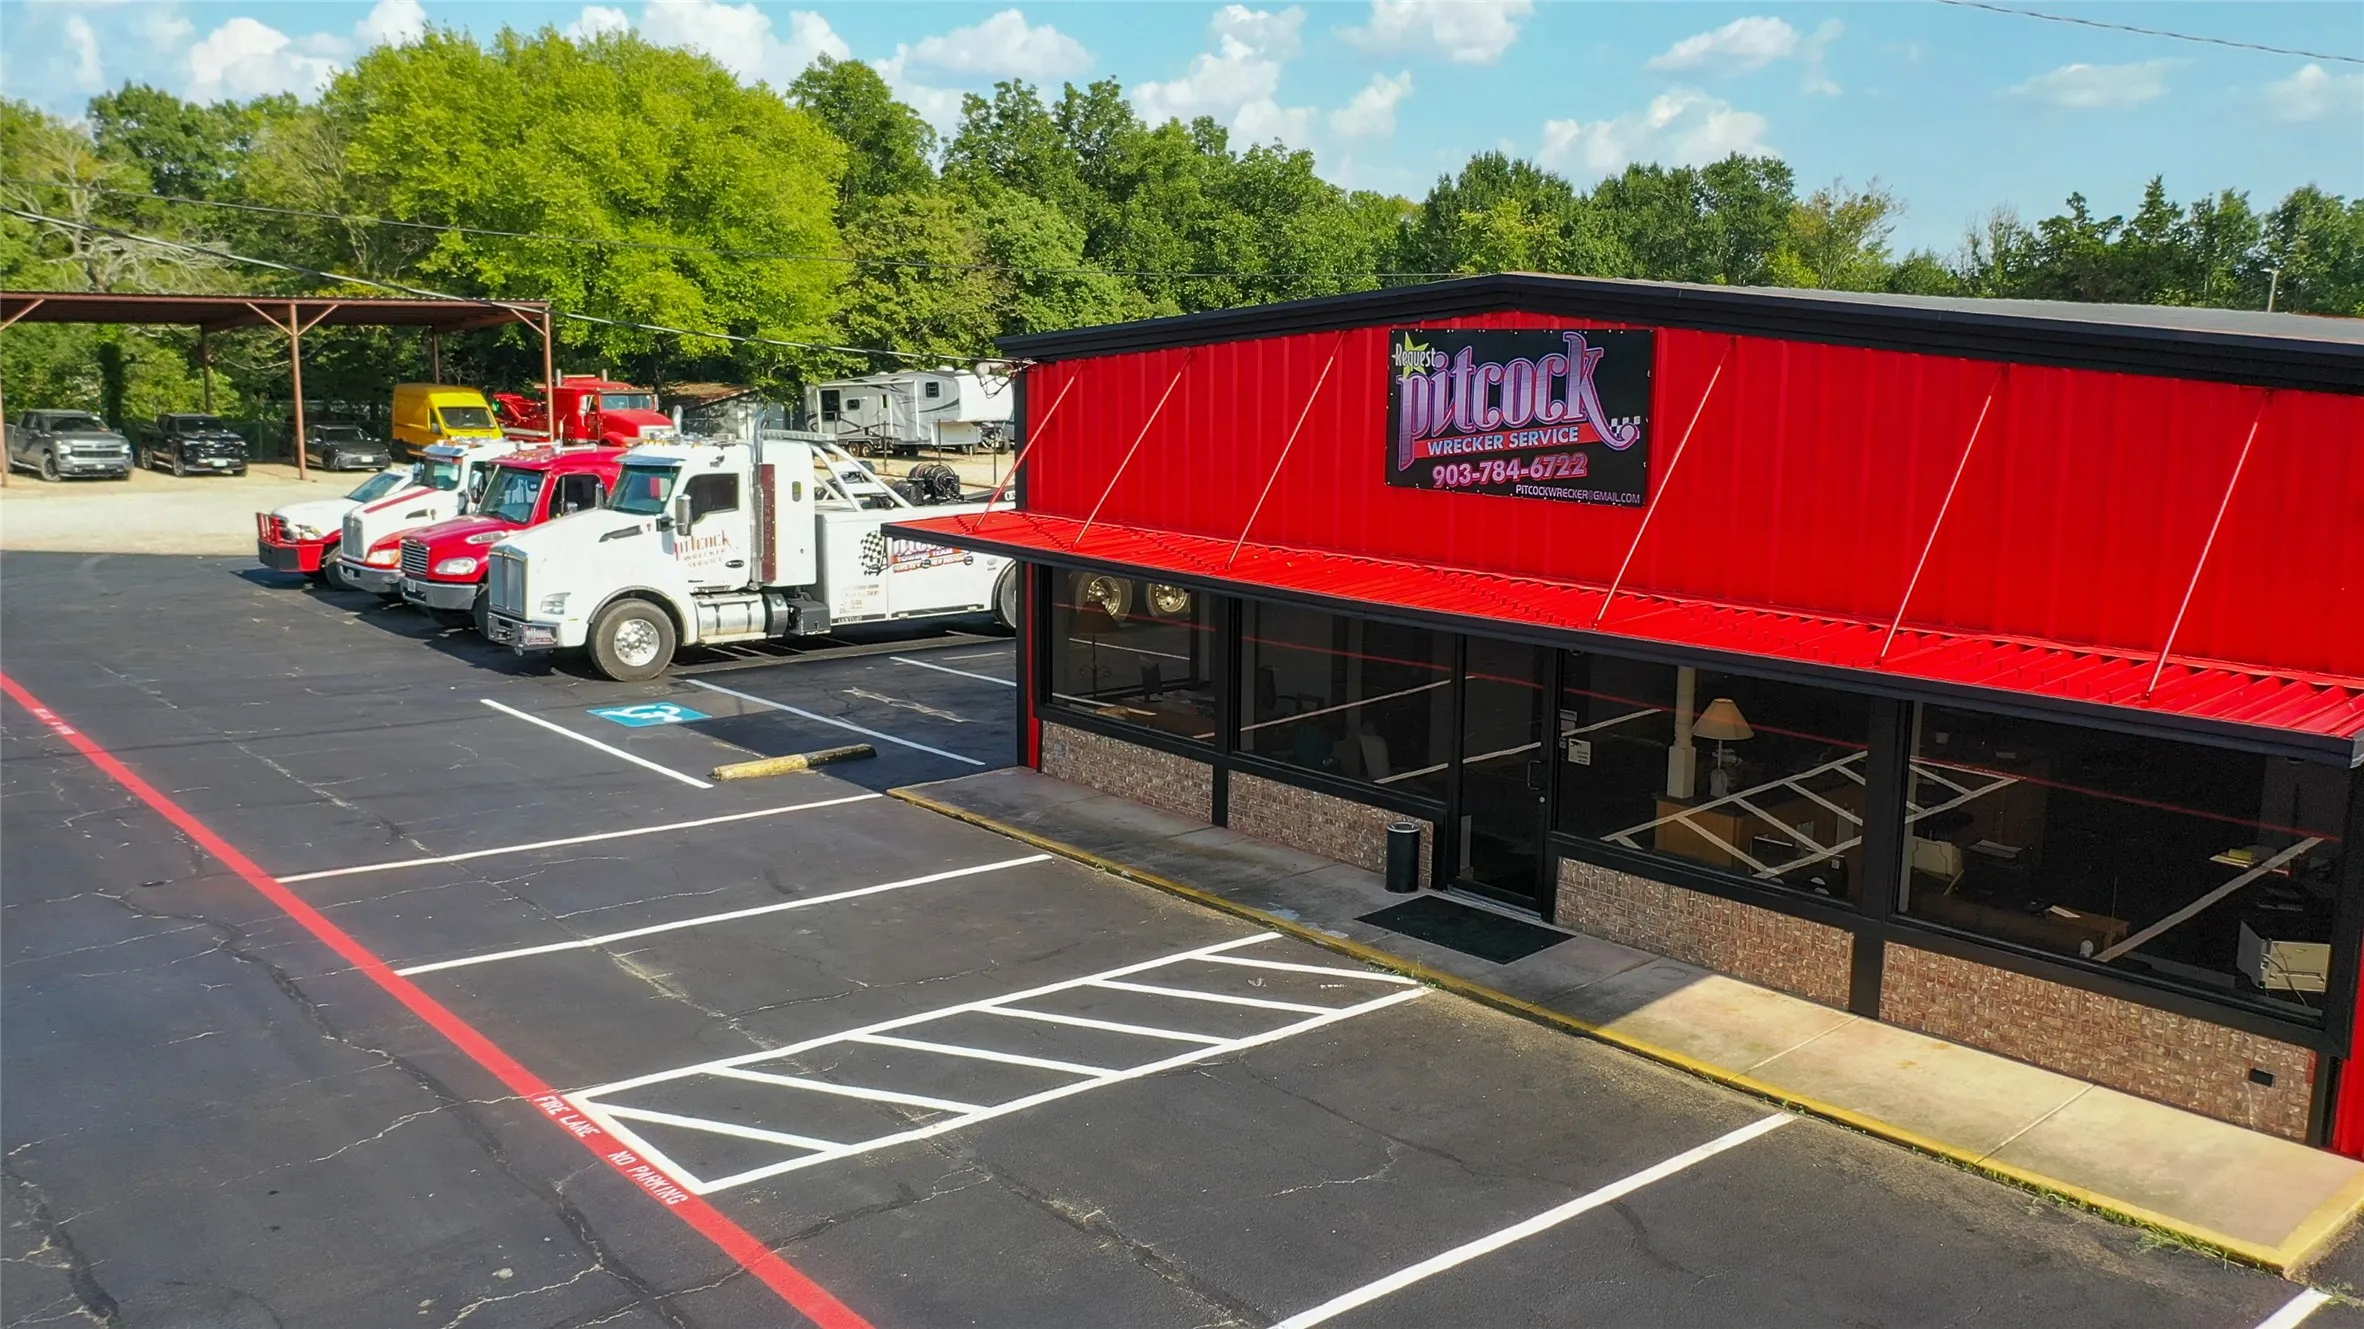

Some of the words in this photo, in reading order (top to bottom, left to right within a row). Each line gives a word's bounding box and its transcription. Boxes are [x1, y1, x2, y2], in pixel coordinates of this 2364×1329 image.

[1395, 342, 1437, 372] Request
[1396, 331, 1640, 472] pitcock
[1427, 434, 1504, 456] WRECKER
[1508, 426, 1579, 448] SERVICE
[1432, 452, 1588, 488] 903-784-6722
[1515, 484, 1640, 504] PITCOCKWRECKER@GMAIL.COM
[533, 1094, 572, 1116] FIRE
[558, 1114, 601, 1138] LANE
[606, 1150, 637, 1166] NO
[626, 1164, 689, 1206] PARKING
